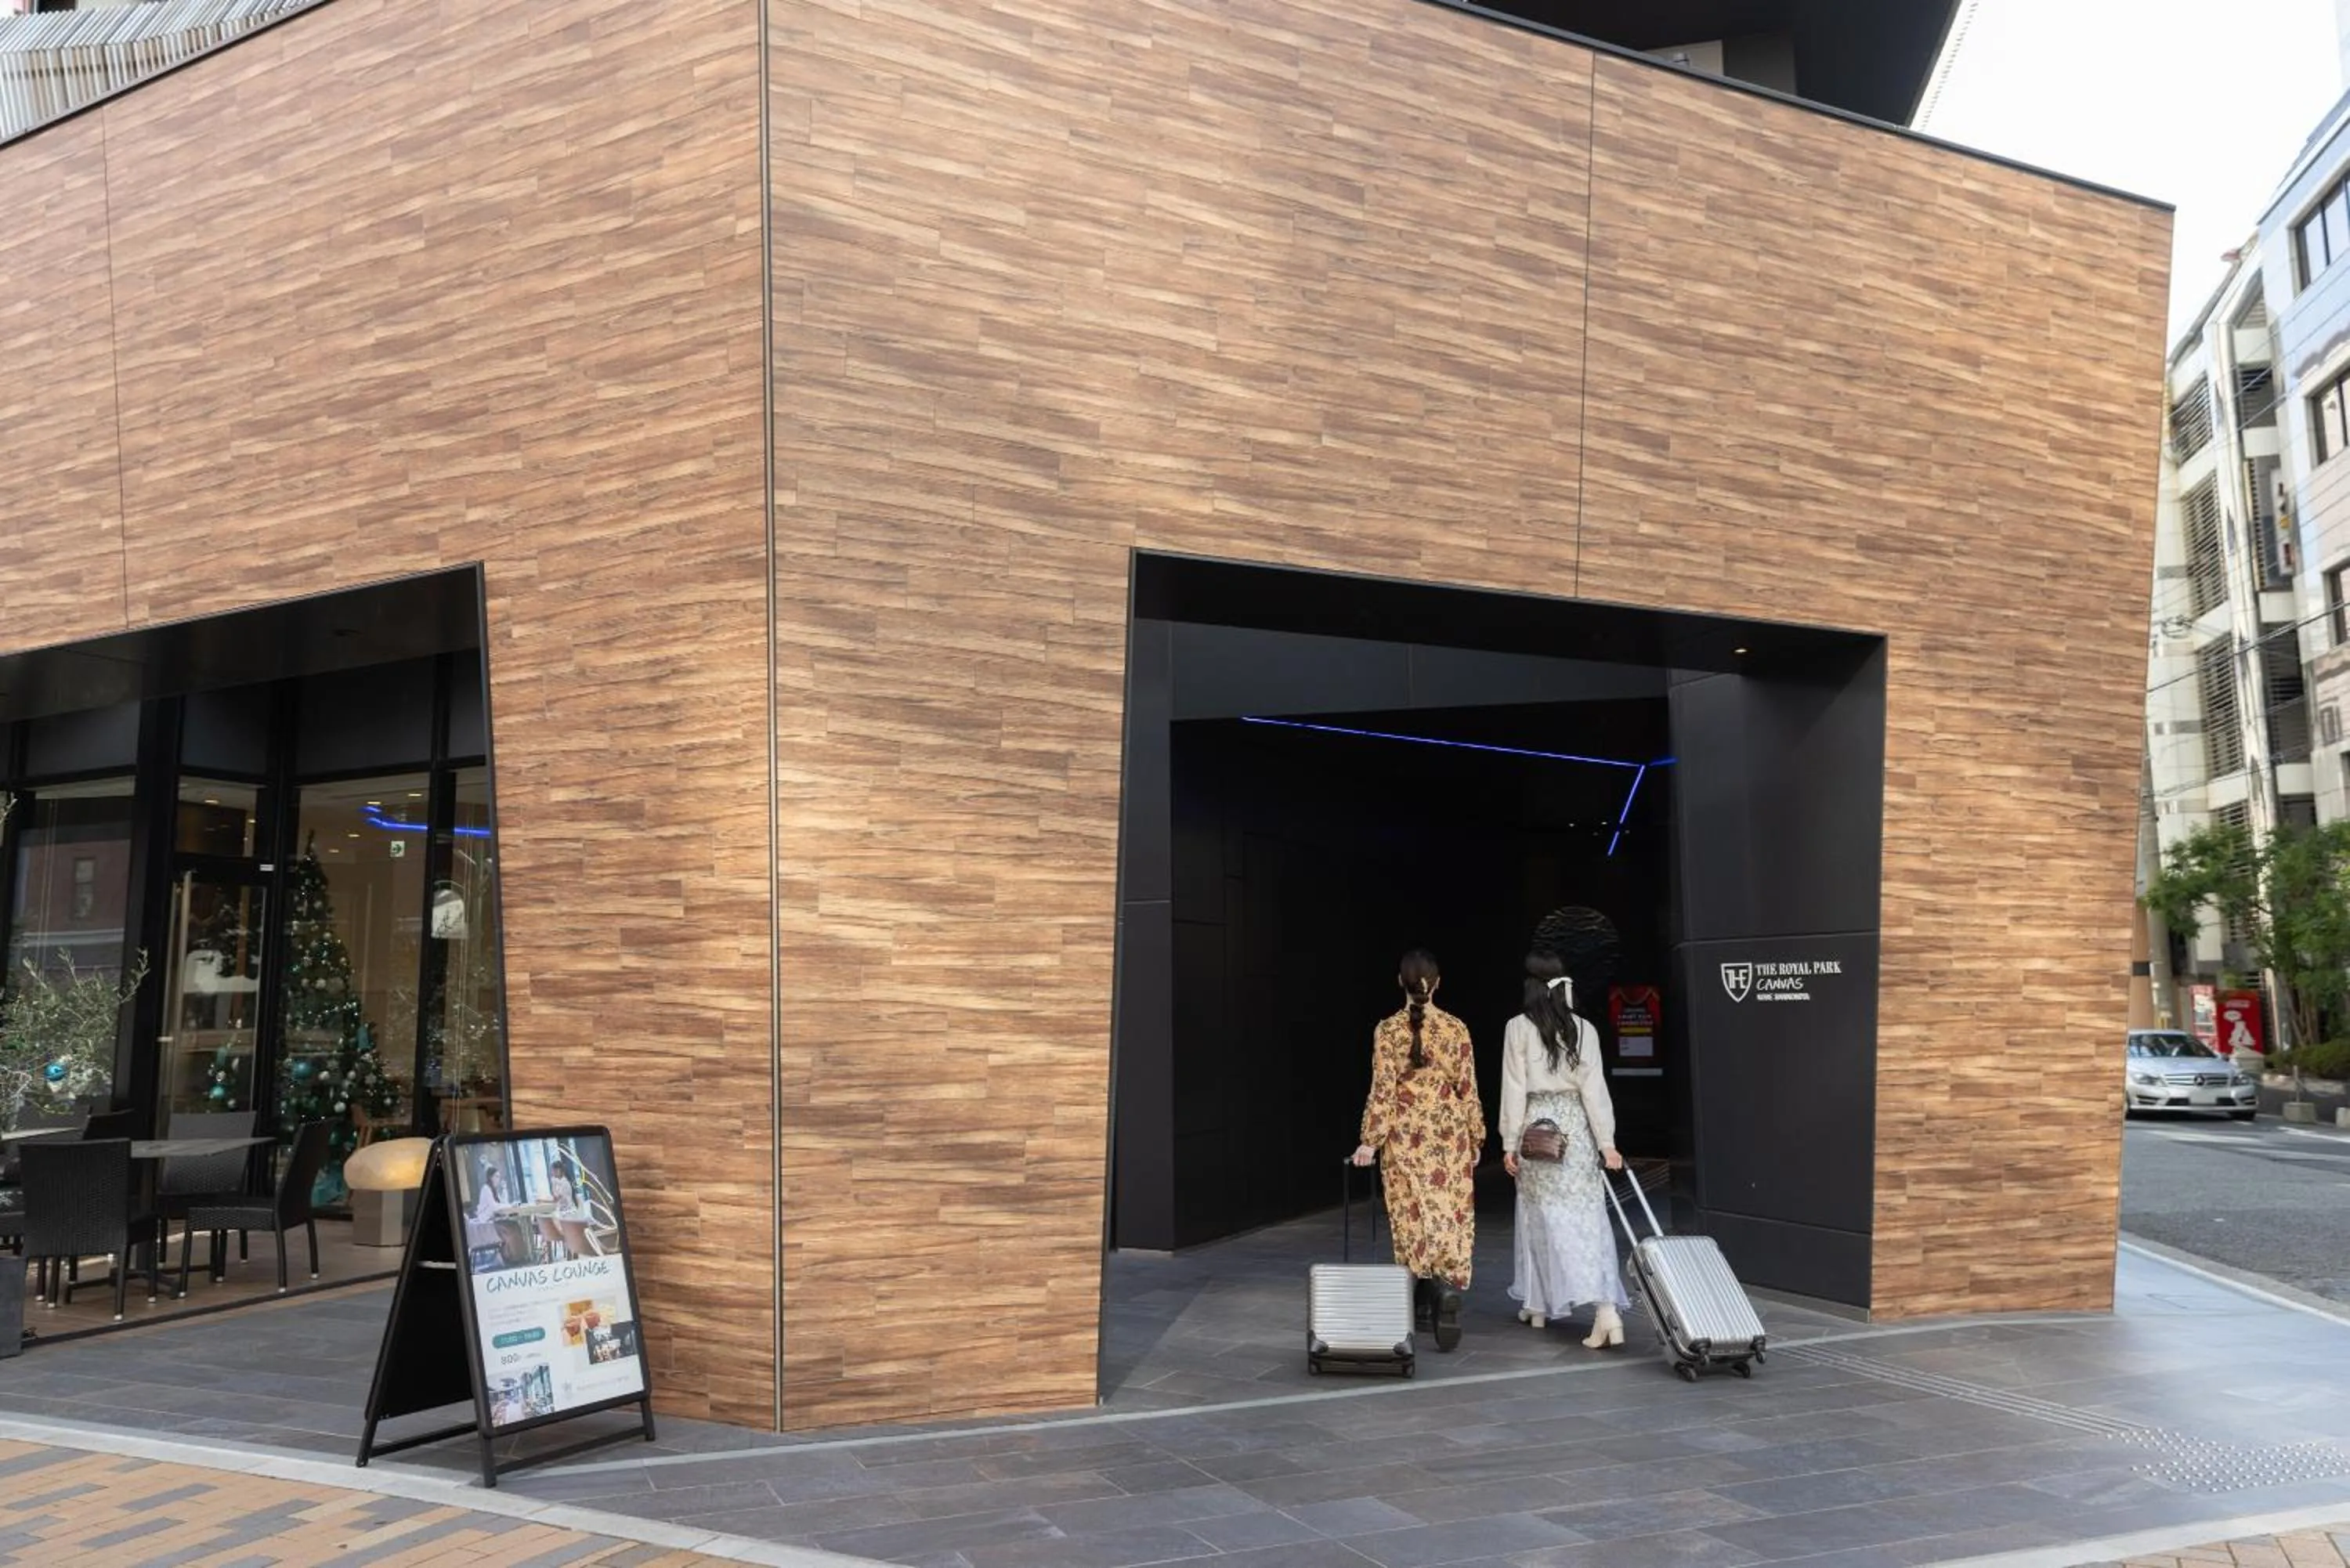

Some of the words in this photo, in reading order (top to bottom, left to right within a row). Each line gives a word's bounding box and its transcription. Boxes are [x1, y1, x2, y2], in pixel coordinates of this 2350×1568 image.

[1755, 963, 1777, 976] THE
[1779, 963, 1811, 975] ROYAL
[1813, 961, 1842, 974] PARK
[1756, 977, 1803, 991] CANVAS
[486, 1269, 548, 1293] CANVAS
[552, 1260, 609, 1282] LOUNGE
